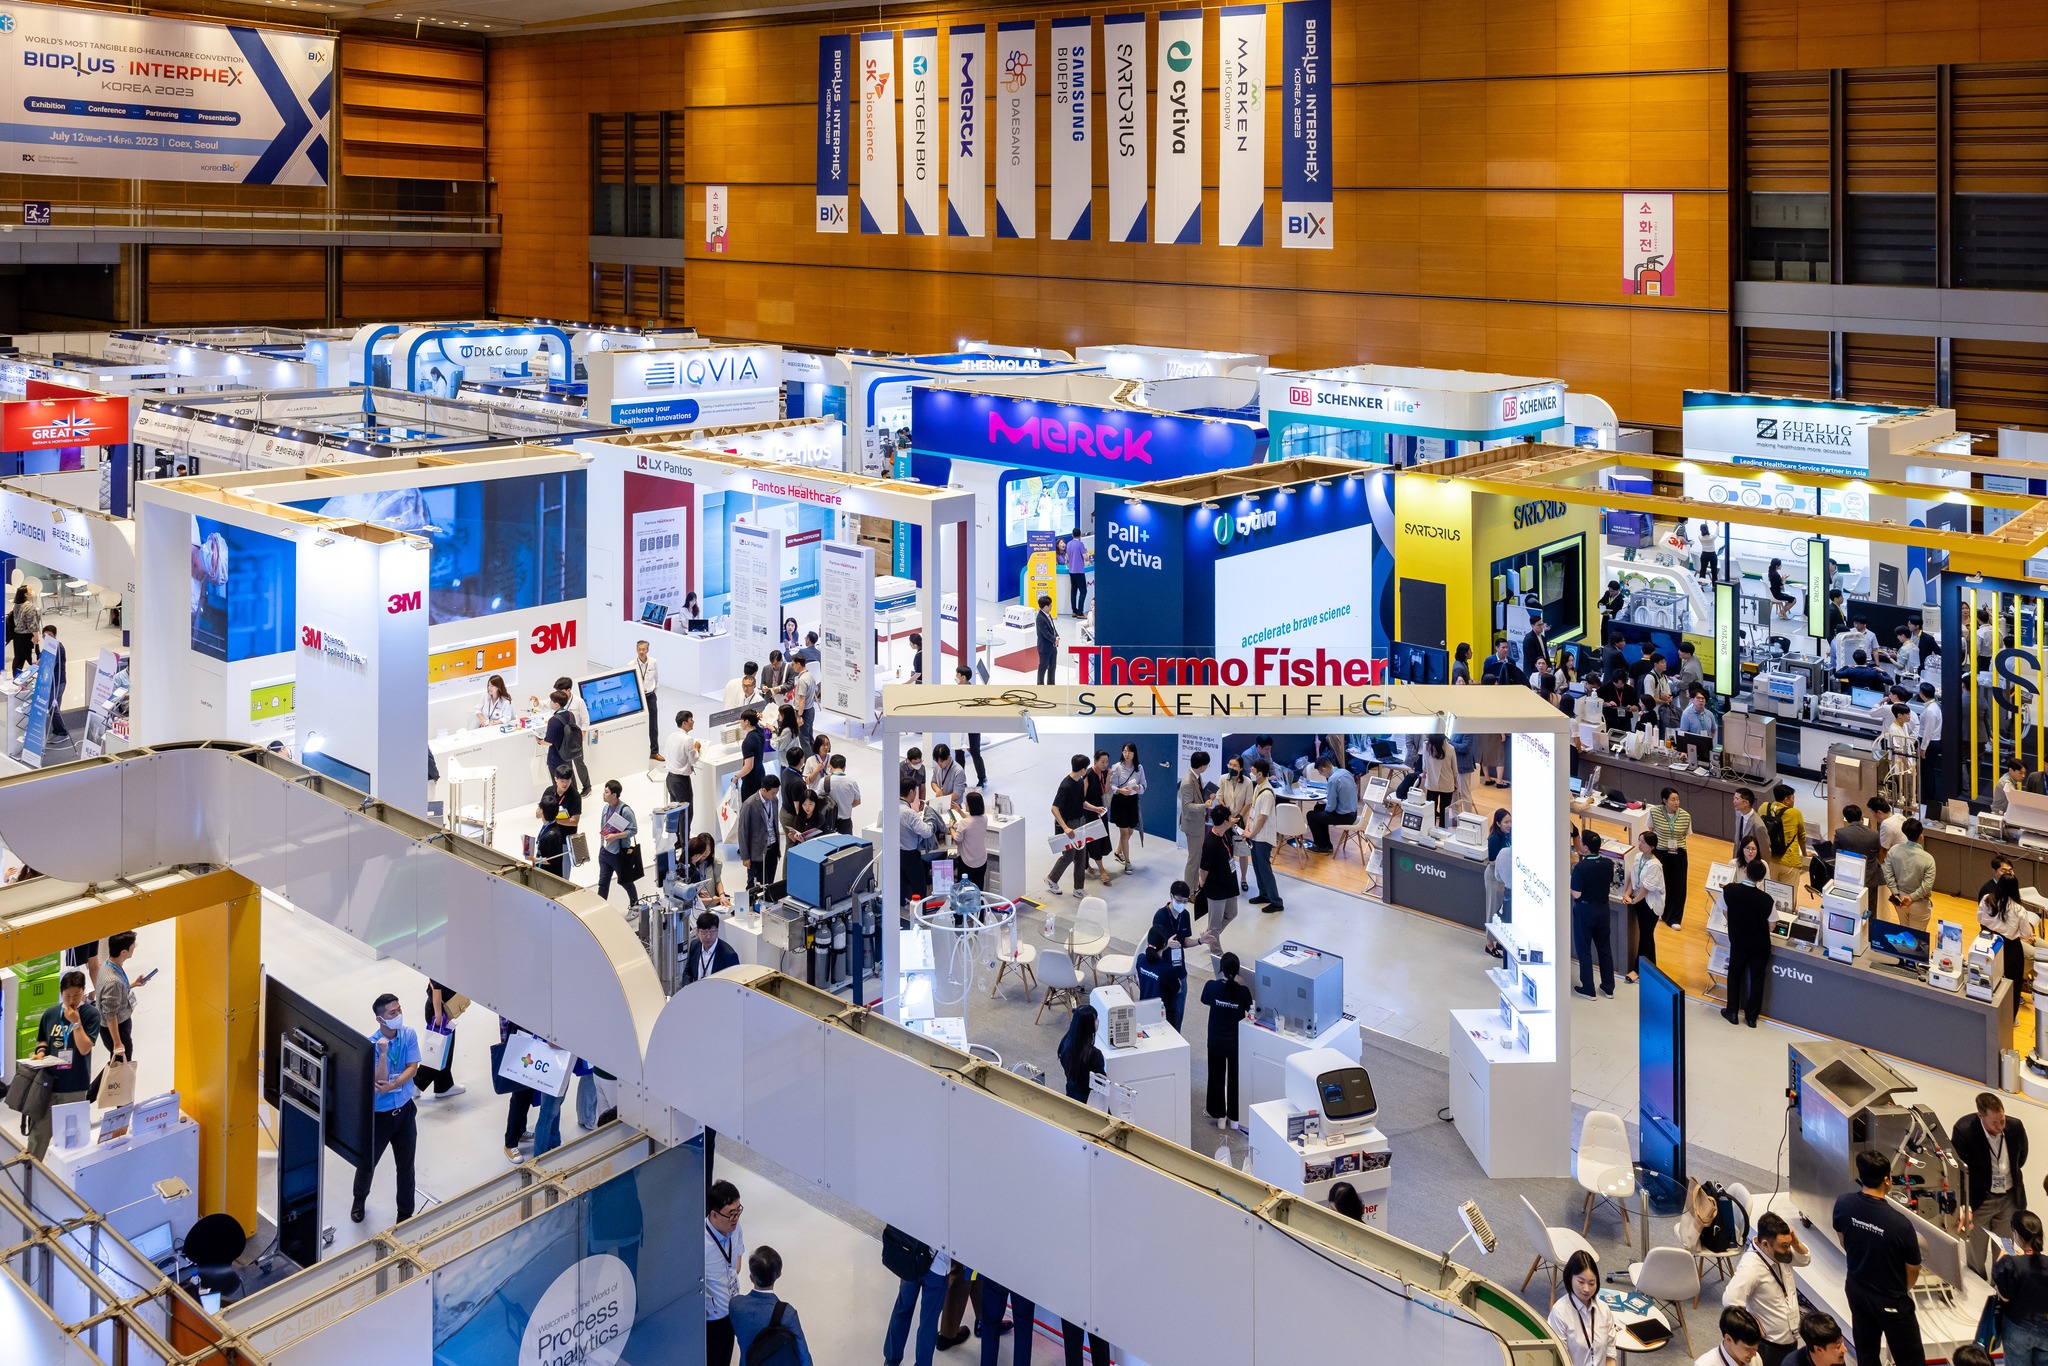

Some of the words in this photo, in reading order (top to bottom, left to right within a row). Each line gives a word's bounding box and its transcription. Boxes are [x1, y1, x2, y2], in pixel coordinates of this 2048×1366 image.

[25, 35, 63, 46] WORLD'S
[64, 38, 88, 48] MOST
[90, 42, 128, 53] TANGIBLE
[129, 46, 194, 60] BIO-HEALTHCARE
[195, 53, 244, 63] CONVENTION
[129, 60, 243, 86] INTERPHEX
[866, 59, 877, 81] SK
[1057, 47, 1068, 104] BIOEPIS
[1224, 67, 1232, 85] UPS
[101, 81, 152, 94] KOREA
[155, 86, 194, 97] 2023
[1072, 46, 1085, 142] SAMSUNG
[1117, 44, 1135, 157] SARTORIUS
[1237, 37, 1248, 152] MARKEN
[31, 101, 66, 110] Exhibition
[88, 105, 127, 115] Conference
[145, 109, 179, 119] Partnering
[198, 113, 237, 122] Presentation
[915, 80, 926, 145] STGEN
[1170, 79, 1190, 154] cytiva
[1223, 86, 1233, 131] Company
[866, 91, 876, 162] bioscience
[1011, 98, 1021, 166] DAESANG
[1293, 107, 1301, 139] 2023
[50, 131, 70, 143] July
[135, 136, 158, 147] 2023
[194, 139, 219, 150] Seoul
[831, 109, 842, 180] INTERPHEX
[1304, 93, 1319, 183] INTERPHEX
[915, 149, 926, 181] BIO
[42, 207, 50, 219] 2
[820, 204, 844, 225] BIX
[1288, 212, 1326, 239] BIX
[1639, 202, 1653, 253] 소화전
[505, 346, 528, 357] Group
[679, 356, 759, 385] IQVIA
[962, 360, 1040, 372] THERMOLAB
[1166, 362, 1198, 377] West
[620, 407, 653, 416] Accelerate
[655, 405, 671, 414] your
[1292, 388, 1310, 404] DB
[1317, 393, 1383, 410] SCHENKER
[1504, 400, 1517, 418] DB
[1519, 395, 1557, 415] SCHENKER
[620, 416, 654, 425] healthcare
[655, 413, 692, 422] innovations
[1783, 421, 1852, 436] ZUELLIG
[32, 428, 71, 440] GREAT
[1783, 431, 1851, 447] PHARMA
[649, 459, 662, 471] LX
[664, 462, 693, 477] Pantos
[1740, 458, 1763, 467] Leading
[1764, 461, 1797, 470] Healthcare
[1797, 464, 1820, 472] Service
[1821, 466, 1844, 475] Partner
[752, 479, 786, 496] Pantos
[787, 484, 842, 506] Healthcare
[1236, 508, 1277, 536] cytiva
[1513, 499, 1568, 530] SARTORIUS
[1404, 522, 1461, 543] SARTORIUS
[1668, 536, 1684, 551] 3M
[1107, 544, 1162, 571] Cytiva
[387, 590, 422, 615] 3M
[302, 625, 321, 650] 3M
[530, 620, 577, 655] 3M
[1242, 619, 1291, 648] accelerate
[1293, 611, 1317, 633] brave
[1319, 603, 1351, 623] science
[1509, 628, 1523, 636] Mass
[323, 644, 344, 659] Applied
[344, 652, 350, 661] to
[1068, 646, 1248, 687] Thermo
[1256, 646, 1388, 687] Fisher
[1077, 692, 1384, 717] SCIENTIFIC
[1415, 862, 1447, 879] cytiva
[1516, 857, 1533, 882] Quality
[1533, 873, 1551, 898] Control
[1523, 879, 1544, 907] Solution
[1772, 963, 1813, 985] cytiva
[534, 1059, 550, 1073] GC
[145, 1111, 168, 1123] testo
[537, 1310, 569, 1334] Welcome
[570, 1306, 578, 1316] to
[579, 1299, 591, 1312] the
[591, 1287, 610, 1304] World
[611, 1282, 619, 1293] of
[538, 1300, 619, 1359] Process
[540, 1323, 619, 1366] Analytics
